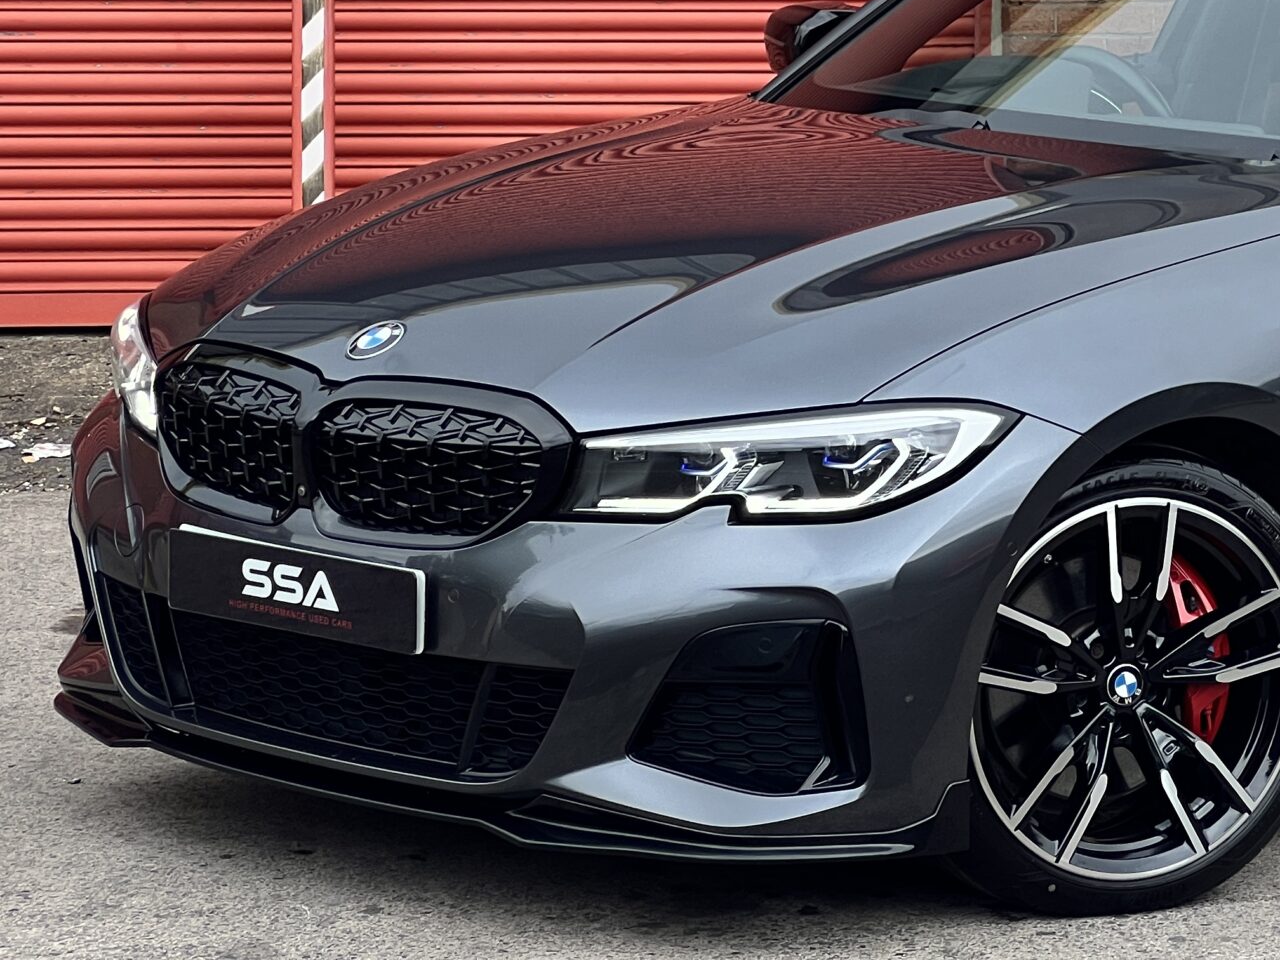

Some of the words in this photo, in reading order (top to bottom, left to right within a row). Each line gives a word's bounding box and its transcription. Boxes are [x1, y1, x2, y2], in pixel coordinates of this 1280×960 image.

[242, 558, 339, 612] SSA
[228, 599, 248, 609] HIGH
[250, 602, 305, 620] PERFORMANCE
[308, 614, 330, 625] USED
[331, 618, 352, 630] CARS
